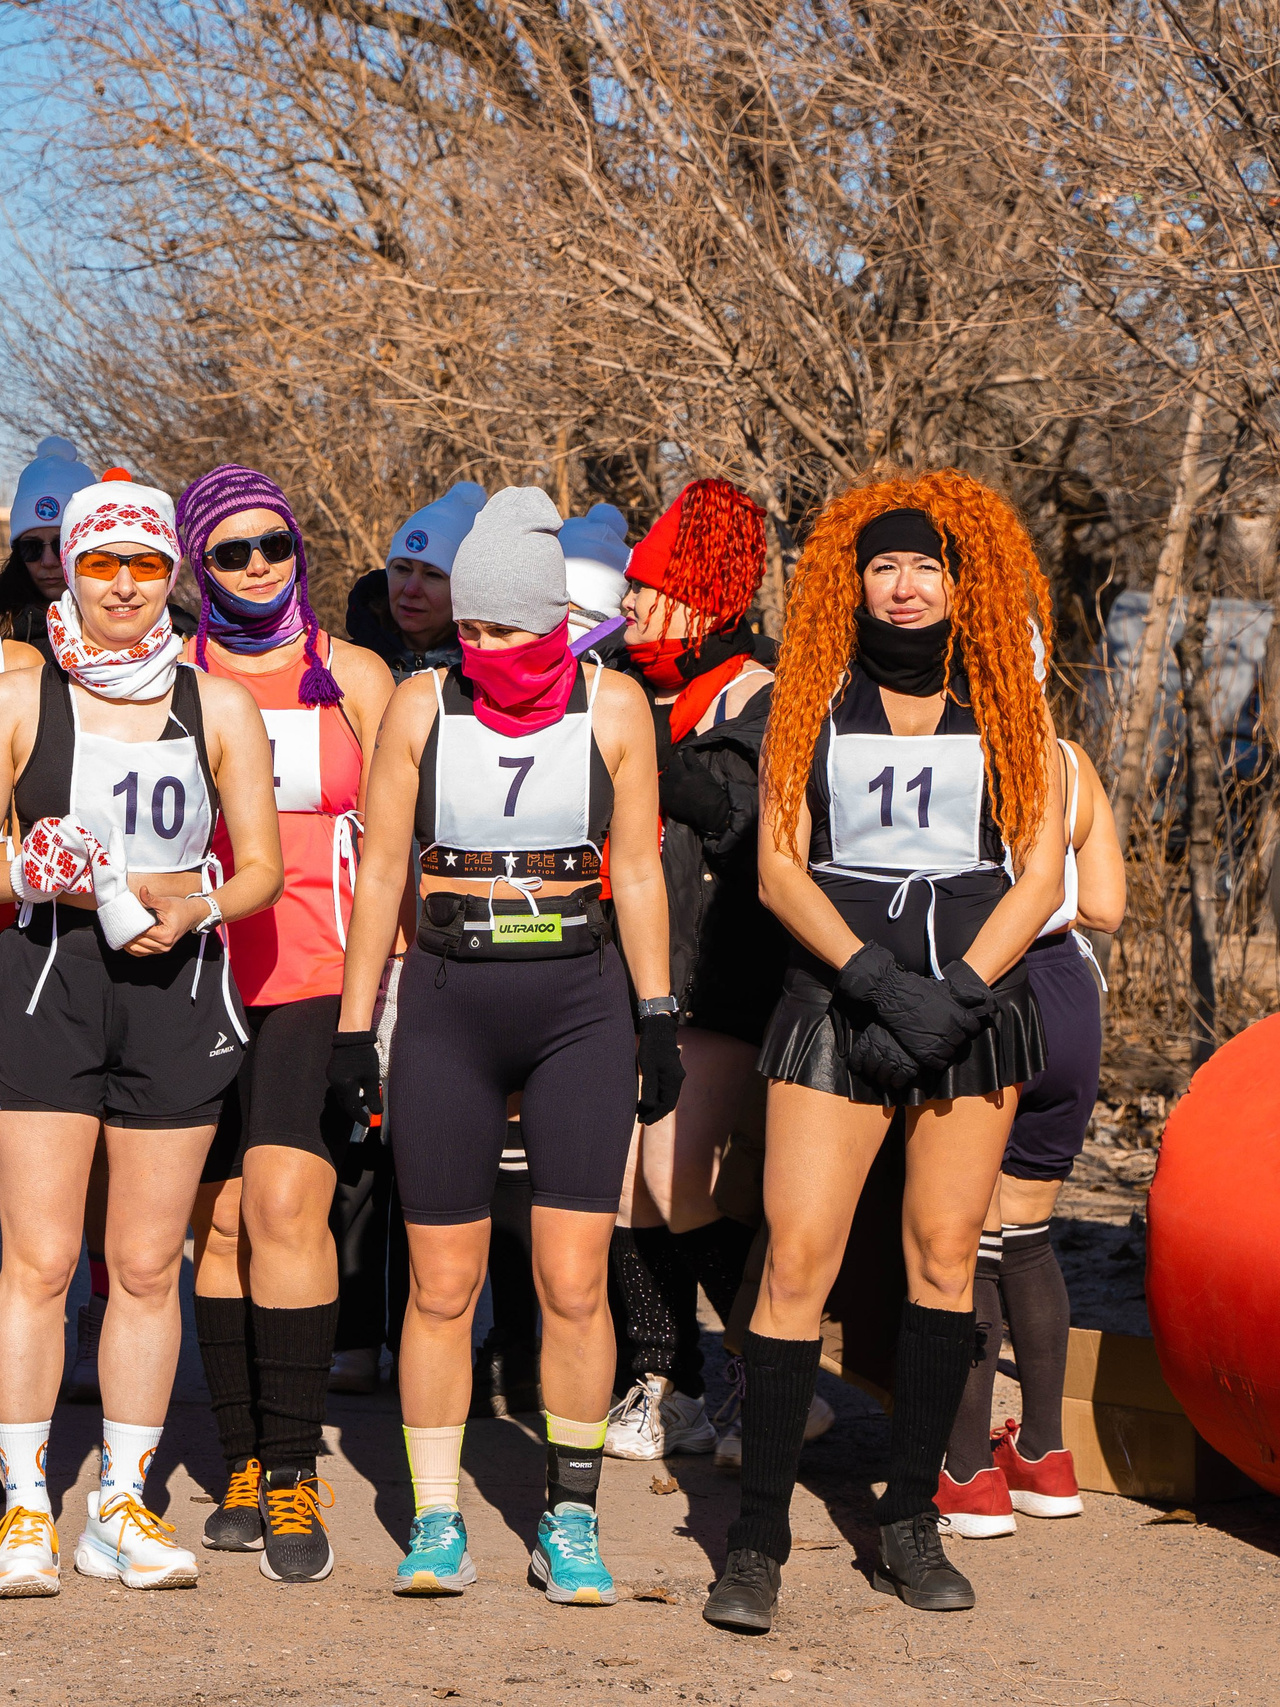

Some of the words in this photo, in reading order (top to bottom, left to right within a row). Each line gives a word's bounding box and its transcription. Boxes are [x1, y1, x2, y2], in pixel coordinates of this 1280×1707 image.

[112, 771, 186, 840] 10
[498, 755, 535, 817] 7
[867, 766, 933, 828] 11
[209, 1045, 235, 1058] DEMIX
